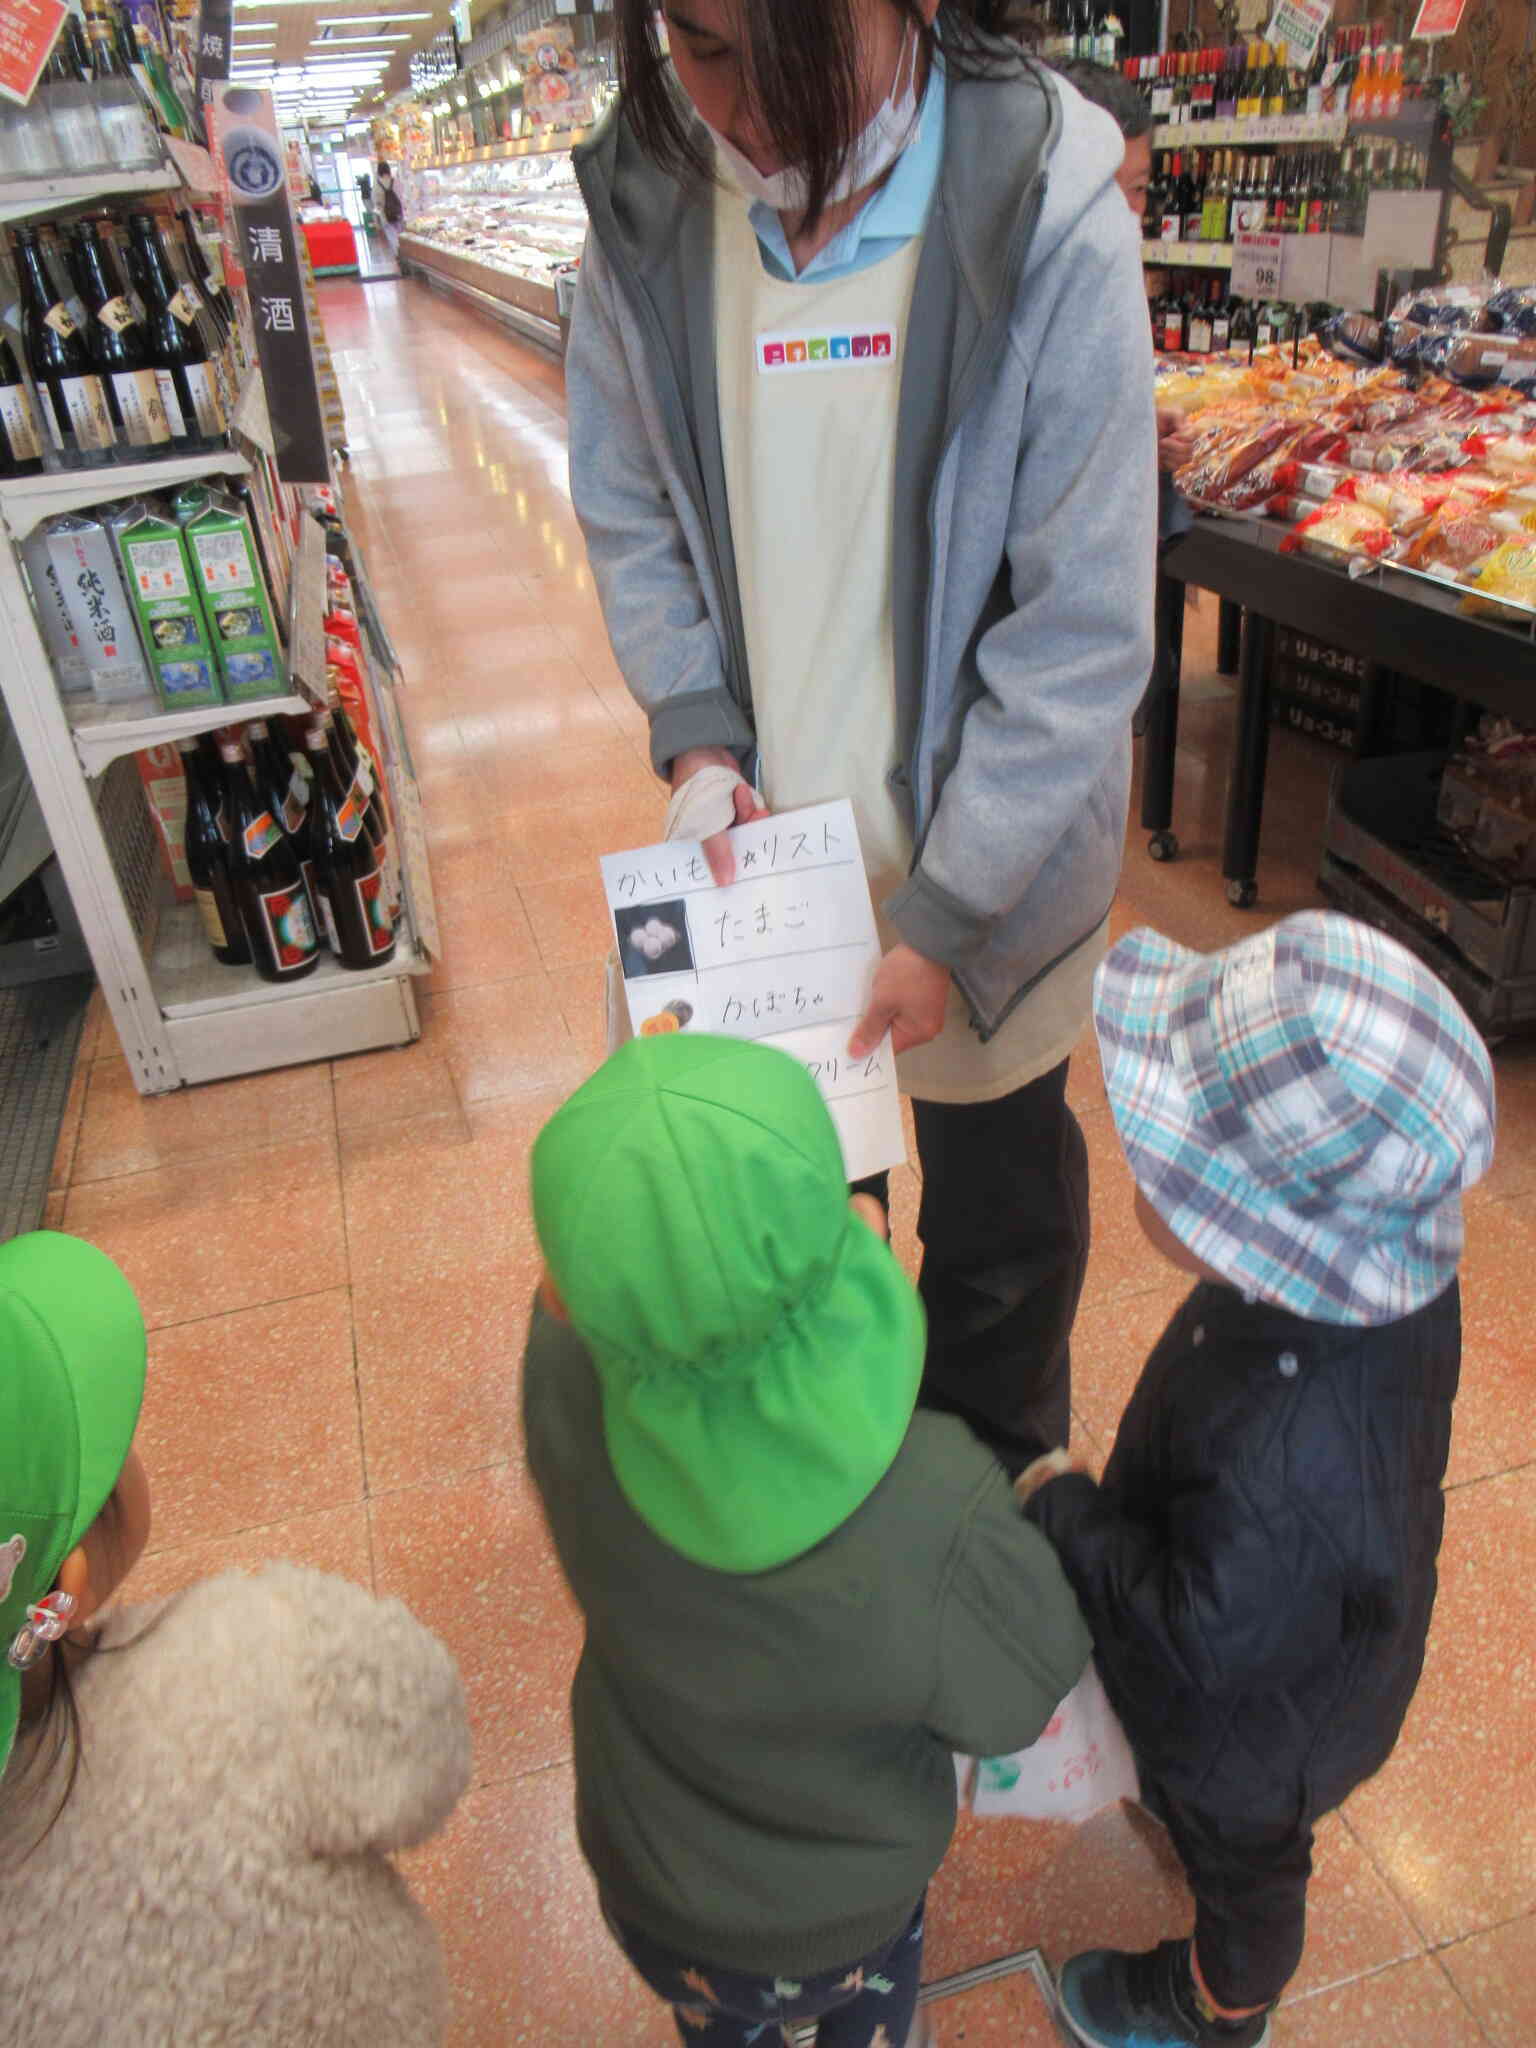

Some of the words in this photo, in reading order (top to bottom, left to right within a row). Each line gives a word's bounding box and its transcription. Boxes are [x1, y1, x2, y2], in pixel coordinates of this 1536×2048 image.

[249, 226, 295, 332] 清酒
[77, 568, 116, 643] 純米酒
[713, 901, 809, 948] たまご
[722, 986, 824, 1024] かぼちゃ
